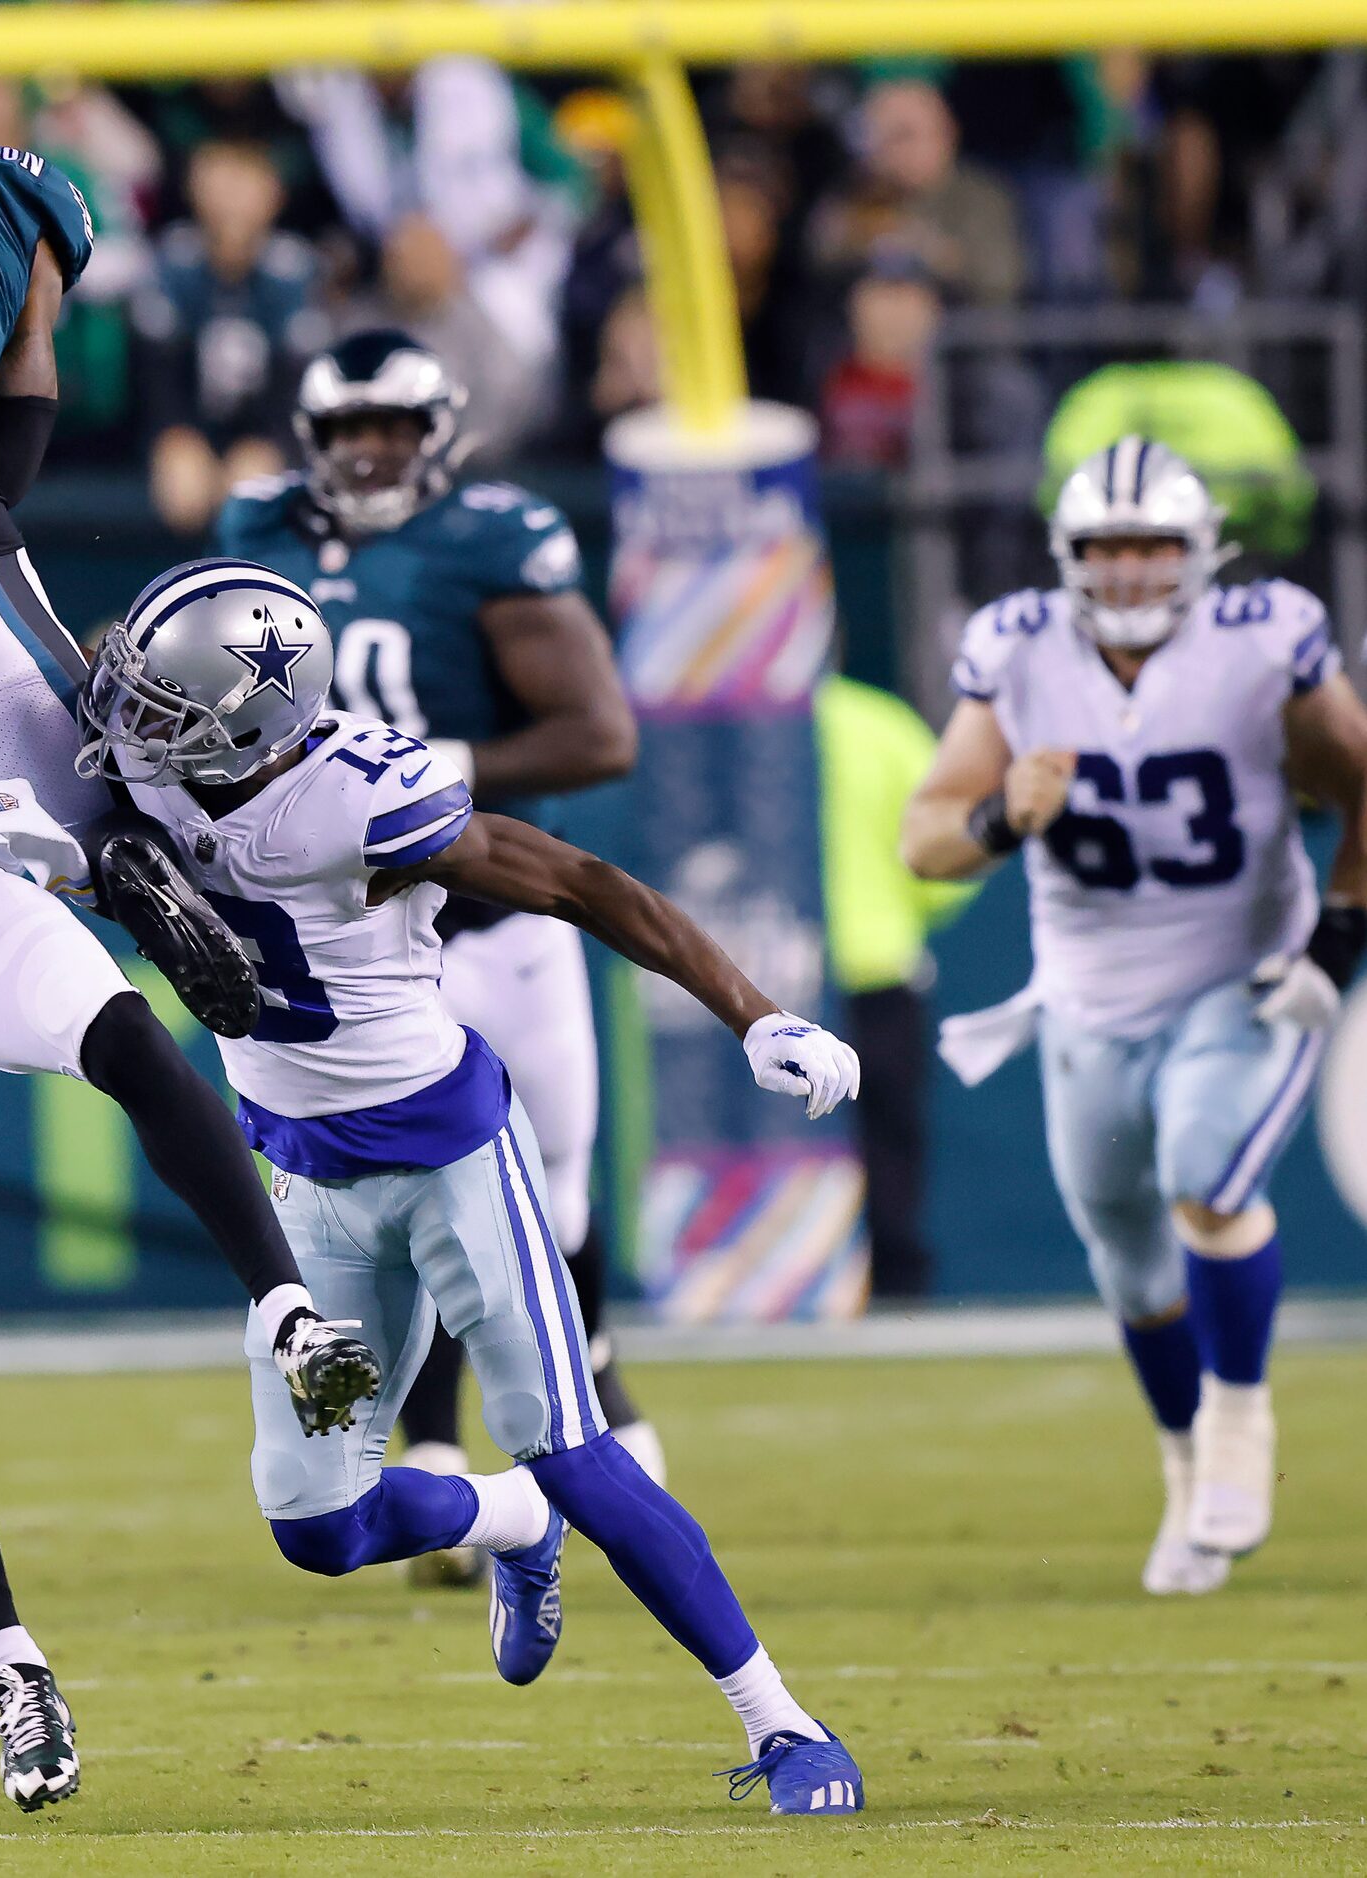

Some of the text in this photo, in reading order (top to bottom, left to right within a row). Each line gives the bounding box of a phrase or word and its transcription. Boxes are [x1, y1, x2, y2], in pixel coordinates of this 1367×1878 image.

[335, 617, 430, 739] 0
[325, 728, 428, 786] 13
[1044, 750, 1246, 889] 63
